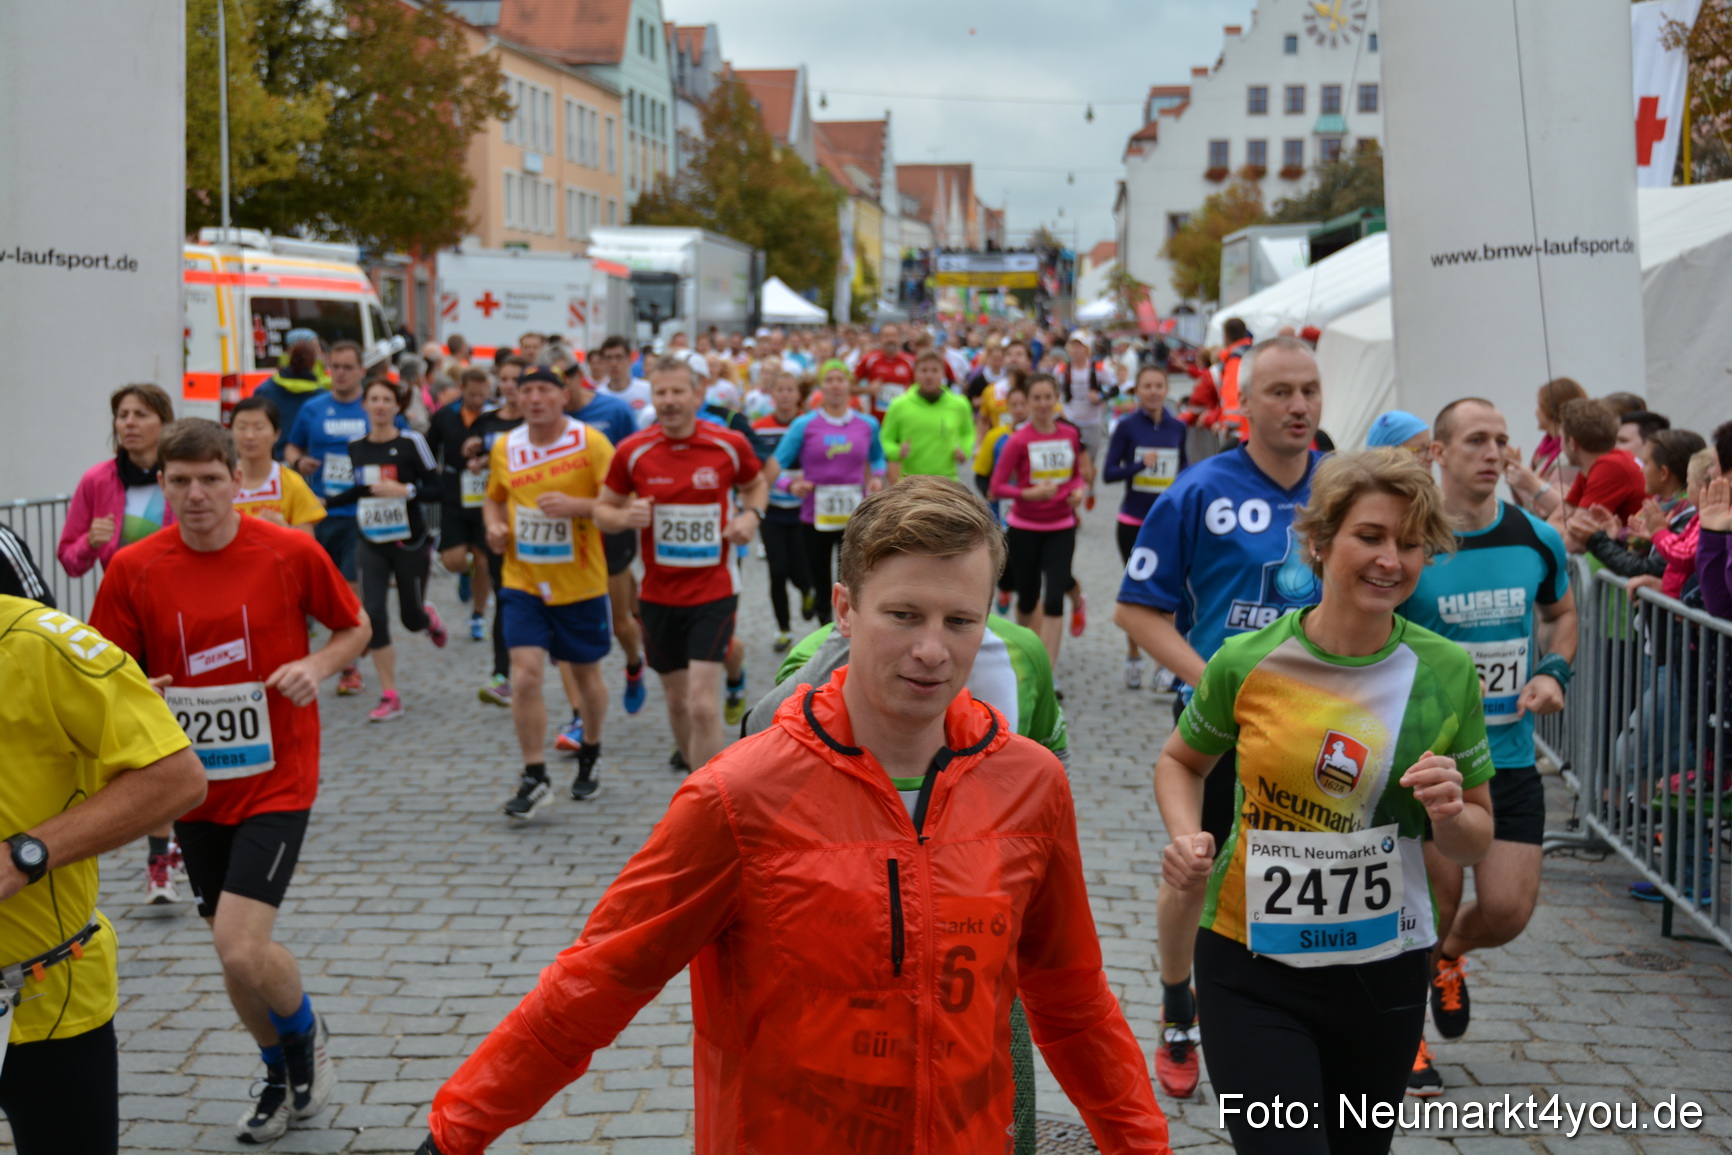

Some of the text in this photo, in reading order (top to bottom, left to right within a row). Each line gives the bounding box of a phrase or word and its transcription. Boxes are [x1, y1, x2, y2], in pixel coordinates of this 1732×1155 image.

[1430, 235, 1635, 268] www.bmw-laufsport.de
[1205, 497, 1272, 535] 60
[520, 520, 567, 542] 2779
[661, 519, 715, 542] 2588
[1437, 587, 1526, 615] HUBER
[197, 694, 247, 706] Neumarkt
[176, 707, 259, 744] 2290
[202, 752, 247, 768] ndreas
[1323, 778, 1346, 794] 1628
[1251, 843, 1378, 861] PARTL Neumarkt
[1263, 861, 1392, 916] 2475
[1299, 928, 1358, 949] Silvia
[937, 945, 976, 1014] 6
